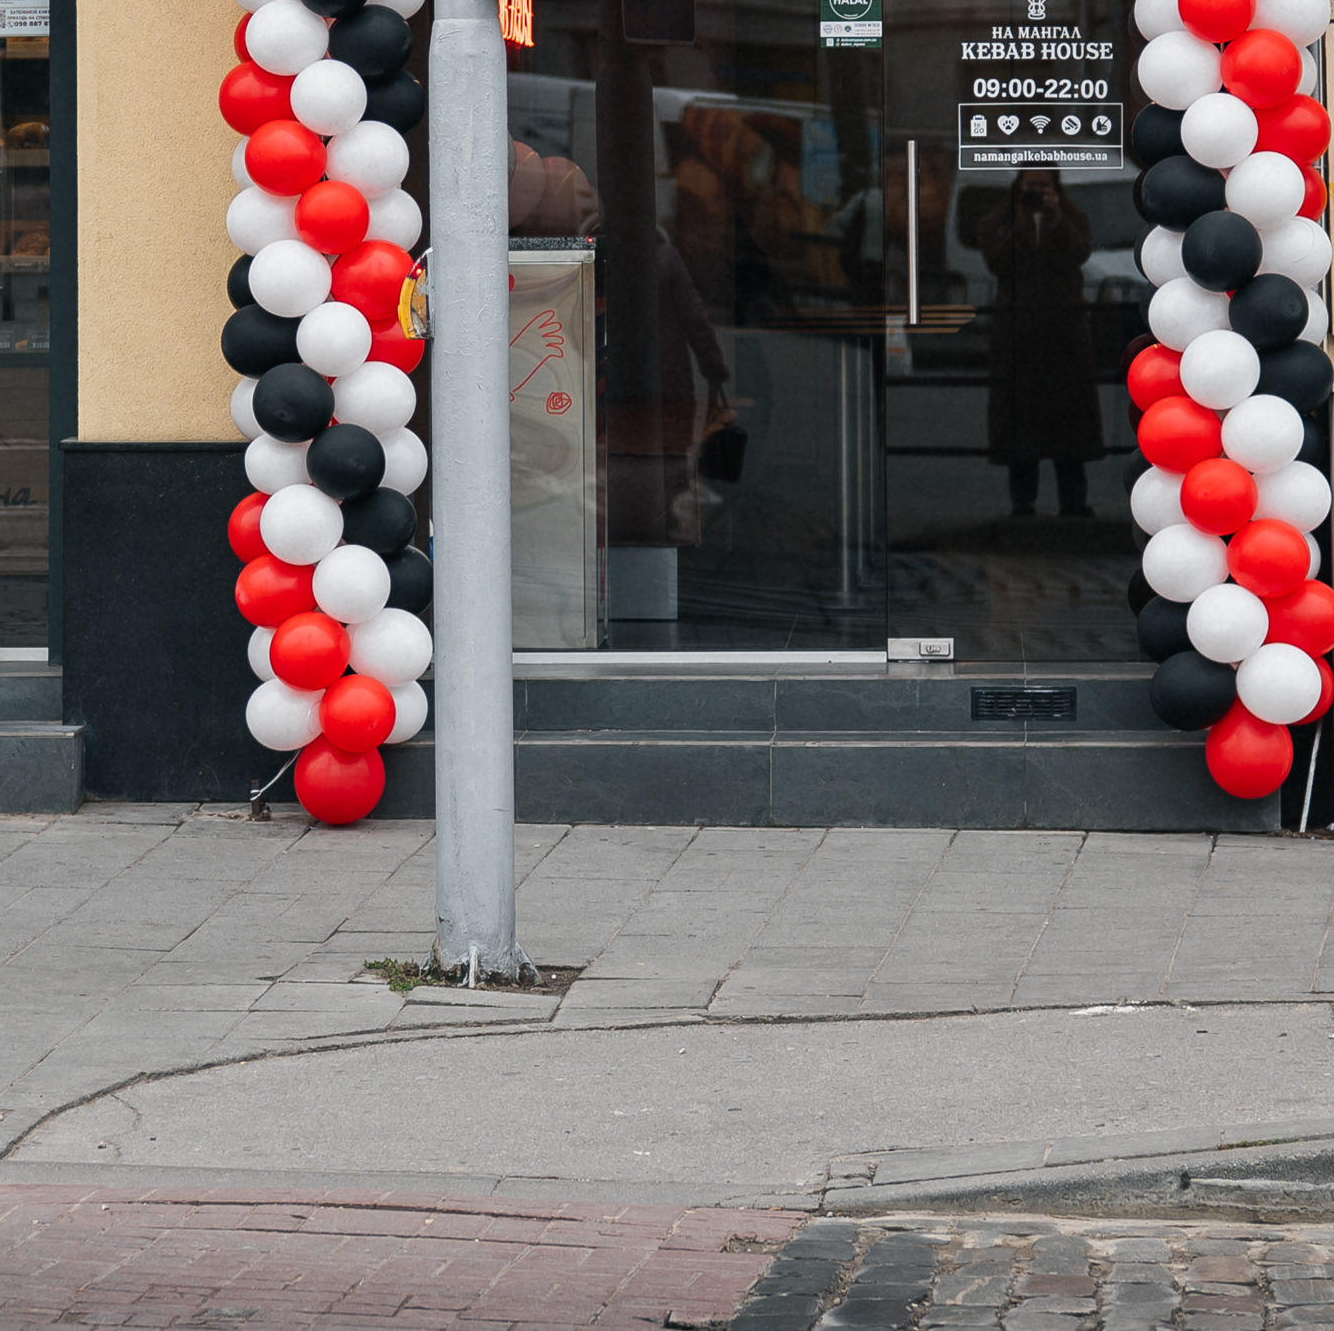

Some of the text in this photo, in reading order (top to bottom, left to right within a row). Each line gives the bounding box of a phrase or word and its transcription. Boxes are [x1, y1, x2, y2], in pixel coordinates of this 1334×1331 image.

[992, 26, 1082, 39] НА МАНГАЛ
[961, 42, 1114, 60] KEBAB HOUSE
[973, 78, 1108, 99] 09:00-22:00
[973, 151, 1108, 164] namangalkebabhouse.ua
